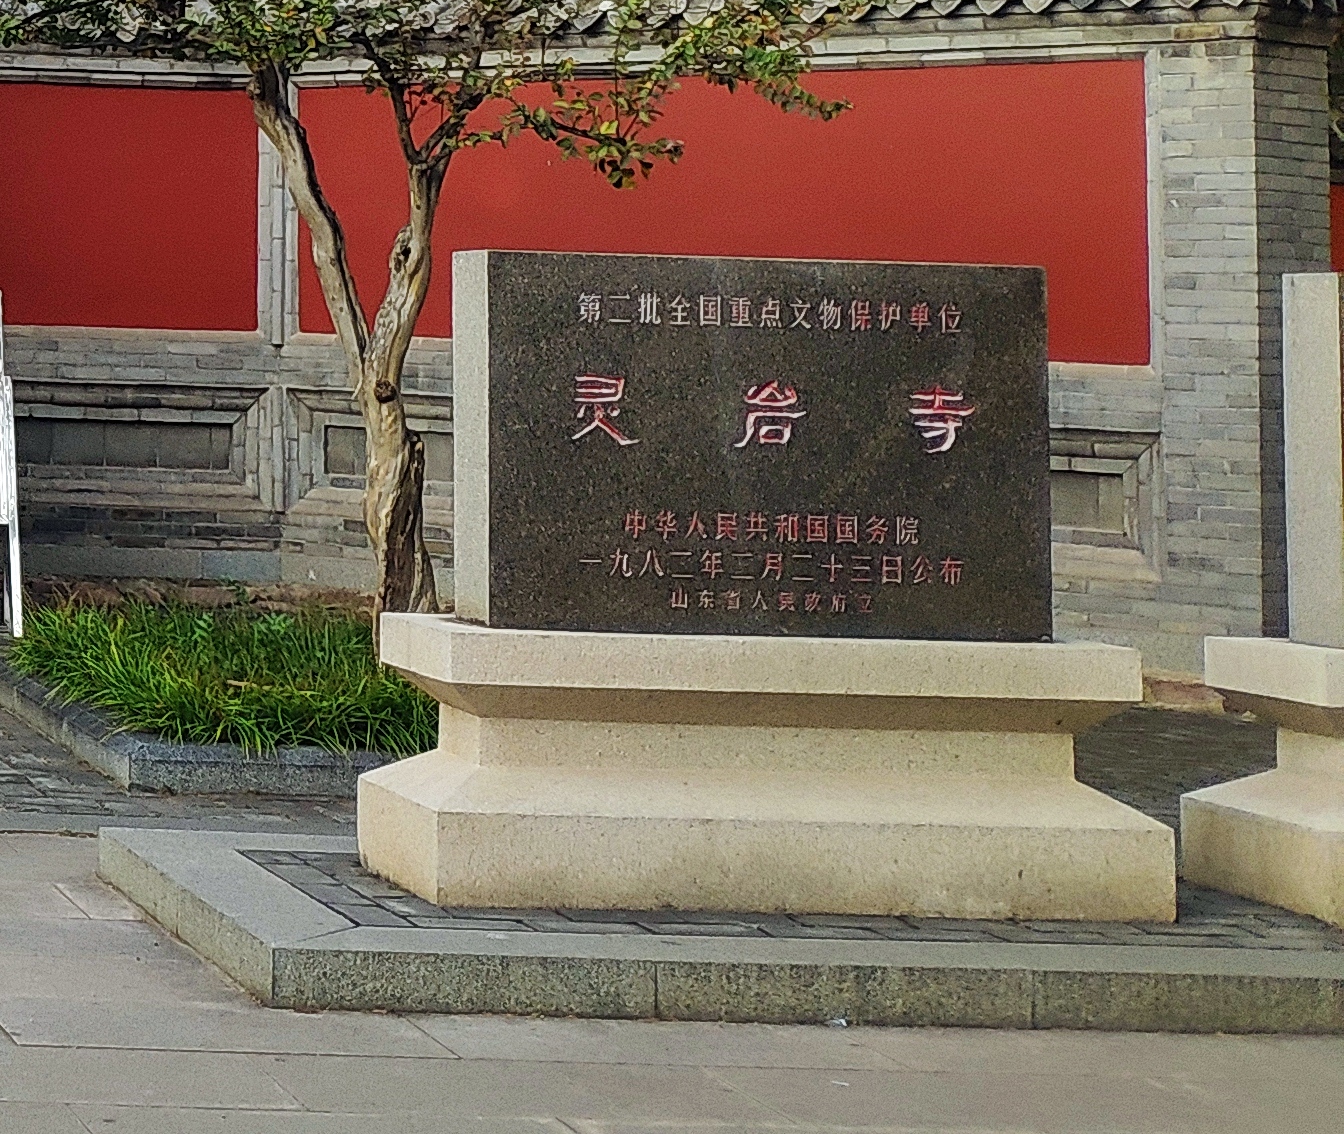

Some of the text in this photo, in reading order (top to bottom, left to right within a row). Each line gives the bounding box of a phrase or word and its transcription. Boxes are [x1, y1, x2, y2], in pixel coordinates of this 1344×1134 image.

[577, 291, 963, 334] 第二批全国重点文物保护单位
[623, 509, 920, 546] 中华人民共和国国务院
[577, 549, 965, 586] 一九八二年二月二十三日公布
[670, 586, 874, 614] 山东省人民政府立
